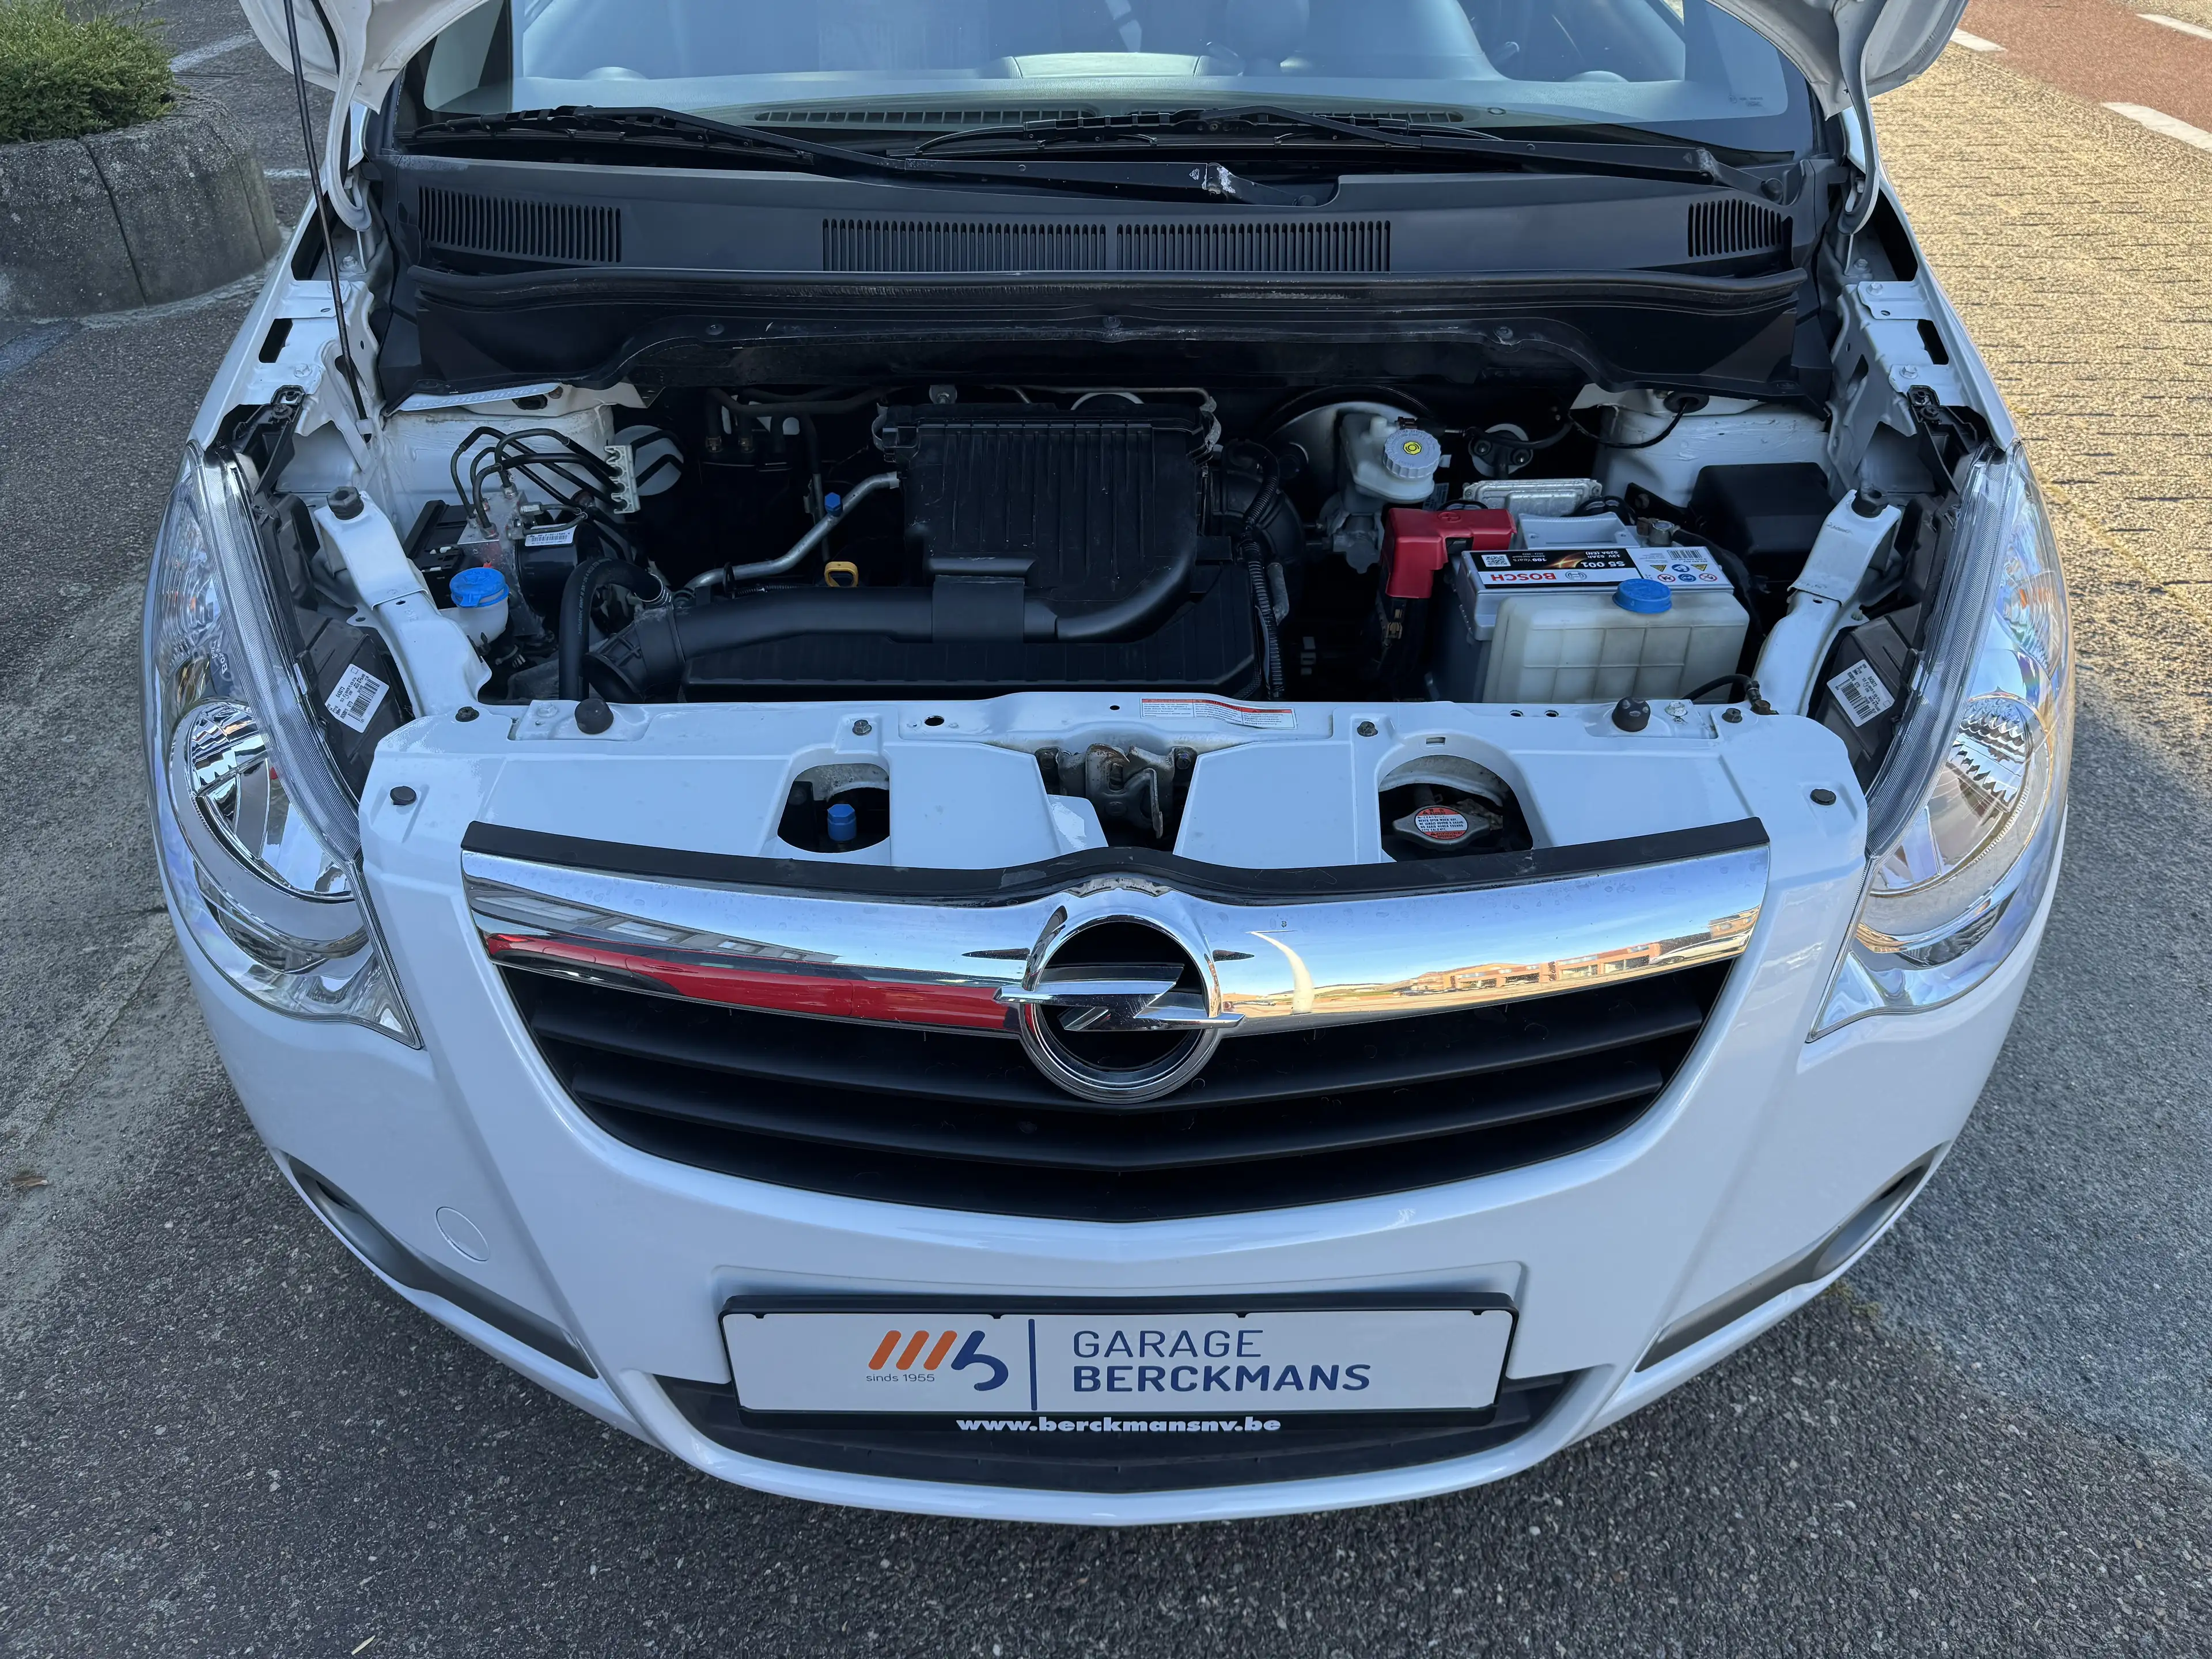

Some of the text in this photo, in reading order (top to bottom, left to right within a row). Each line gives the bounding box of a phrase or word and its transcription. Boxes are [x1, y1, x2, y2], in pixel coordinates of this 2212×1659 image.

[1490, 573, 1556, 581] BOSCH
[1073, 1330, 1263, 1358] GARAGE
[866, 1374, 935, 1382] sinds 1955
[1073, 1363, 1371, 1392] BERCKMANS
[956, 1416, 1281, 1431] www.berckmansnv.be
